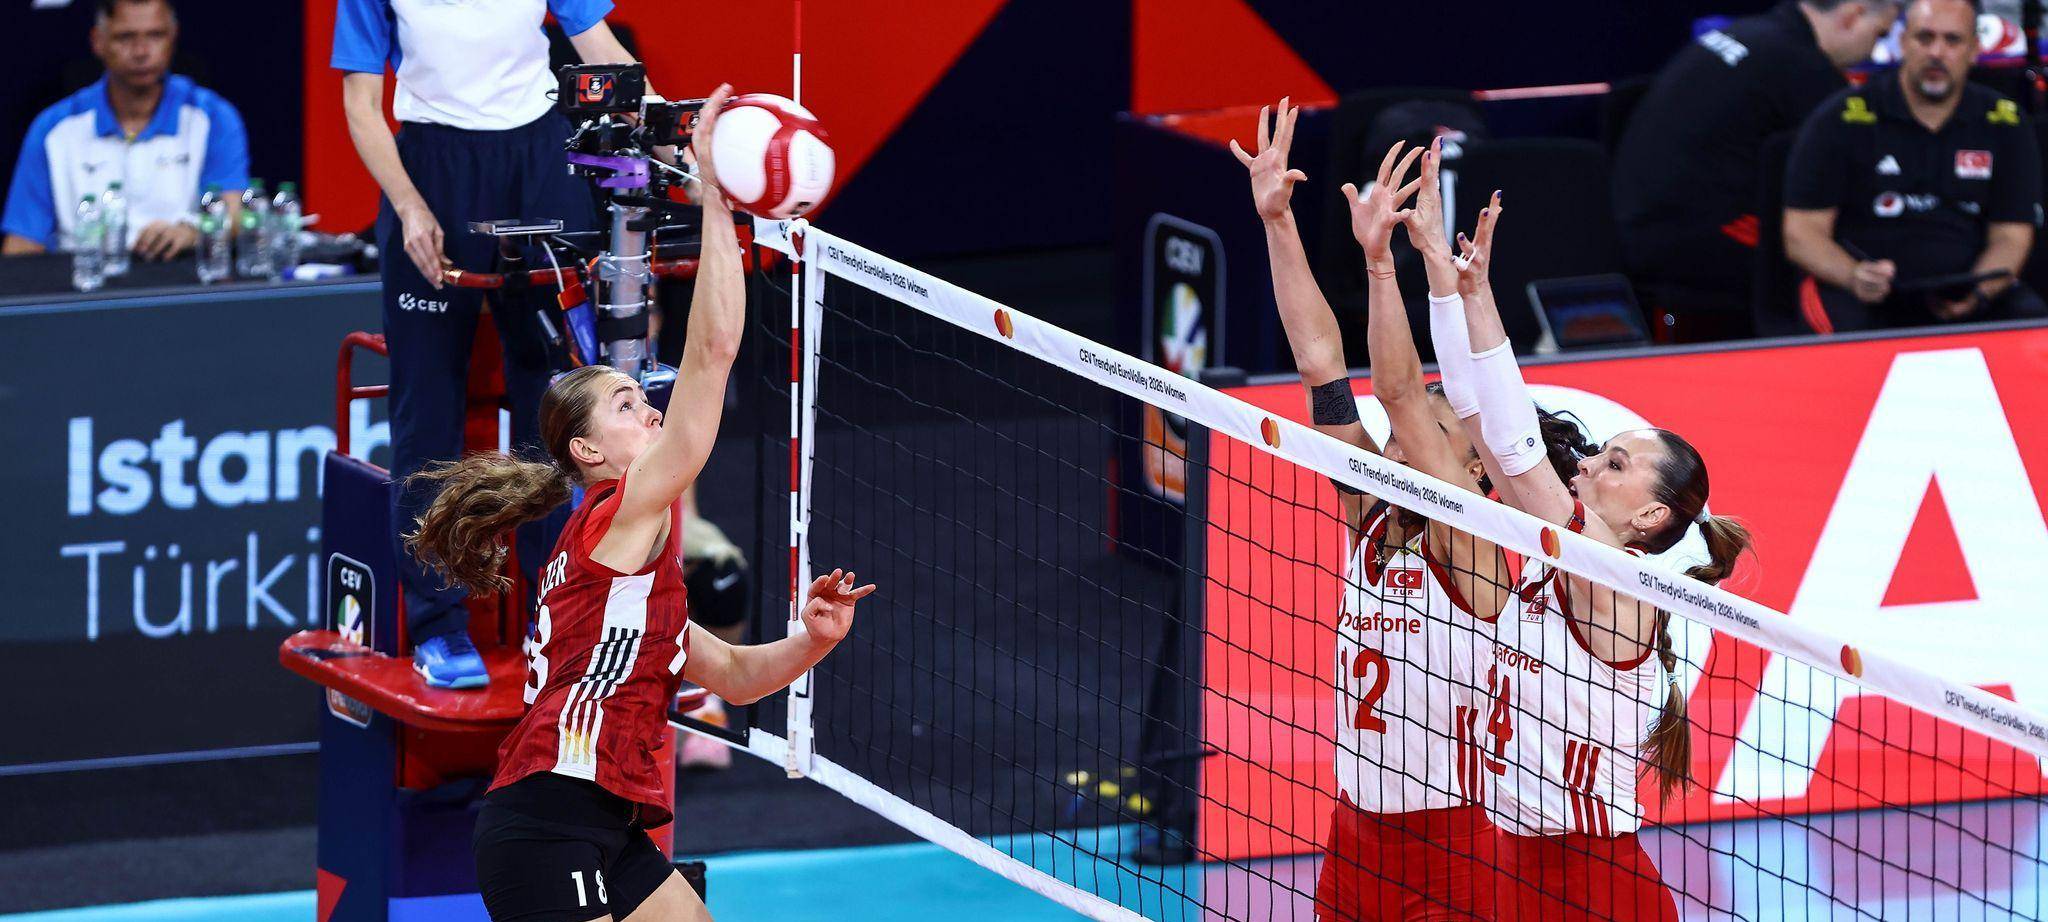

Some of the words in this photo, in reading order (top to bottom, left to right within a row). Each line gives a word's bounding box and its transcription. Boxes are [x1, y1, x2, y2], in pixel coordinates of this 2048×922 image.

[828, 246, 839, 260] CEV
[840, 250, 863, 271] Trendyol
[864, 260, 892, 285] EuroVolley
[892, 272, 906, 289] 2026
[907, 278, 929, 298] Women
[417, 299, 449, 313] CEV
[1080, 348, 1092, 364] CEV
[1092, 353, 1117, 376] Trendyol
[1118, 363, 1147, 390] EuroVolley
[1148, 376, 1164, 393] 2026
[1164, 382, 1187, 402] Women
[68, 398, 392, 517] Istanb
[1348, 457, 1361, 474] CEV
[1362, 462, 1390, 486] Trendyol
[1391, 473, 1422, 501] EuroVolley
[1422, 486, 1438, 504] 2026
[1438, 492, 1464, 514] Women
[60, 527, 322, 641] Türki
[340, 566, 362, 590] CEV
[1392, 588, 1414, 596] TUR
[1639, 571, 1653, 587] CEV
[1654, 577, 1683, 600] Trendyol
[1683, 588, 1717, 616] EuroVolley
[1717, 602, 1734, 620] 2026
[1734, 608, 1760, 630] Women
[1945, 690, 1959, 706] CEV
[1960, 694, 1990, 720] Trendyol
[571, 869, 608, 907] 18
